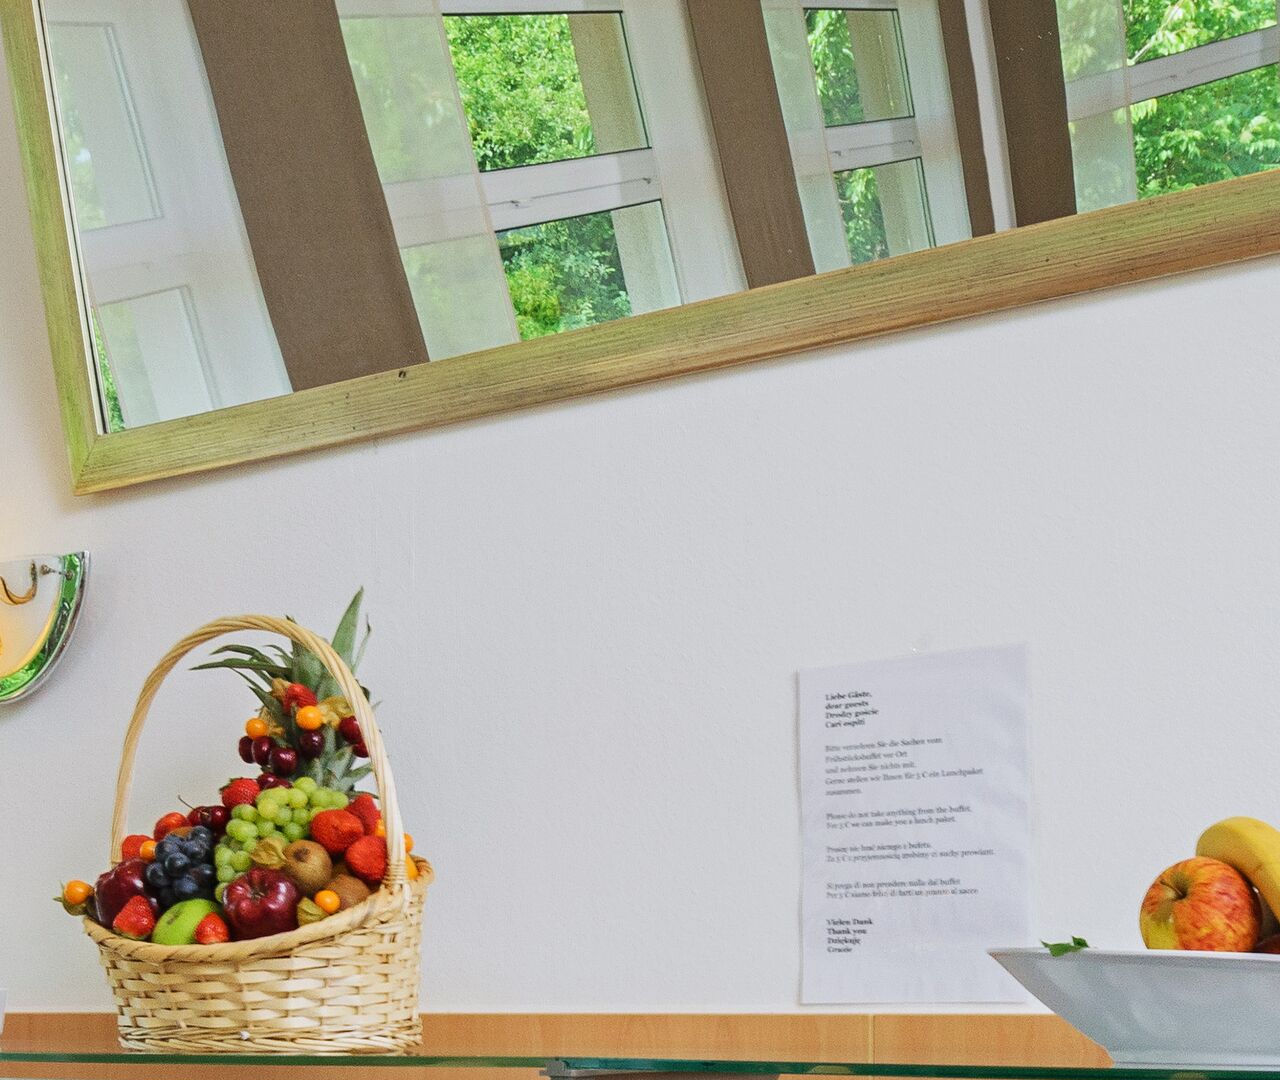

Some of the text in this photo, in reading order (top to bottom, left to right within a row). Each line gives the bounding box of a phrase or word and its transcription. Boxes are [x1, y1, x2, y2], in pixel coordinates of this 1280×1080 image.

[825, 693, 847, 701] Liebe
[844, 701, 869, 710] guests
[901, 738, 925, 746] Sachen
[886, 808, 916, 817] anything
[825, 918, 851, 926] Vielen
